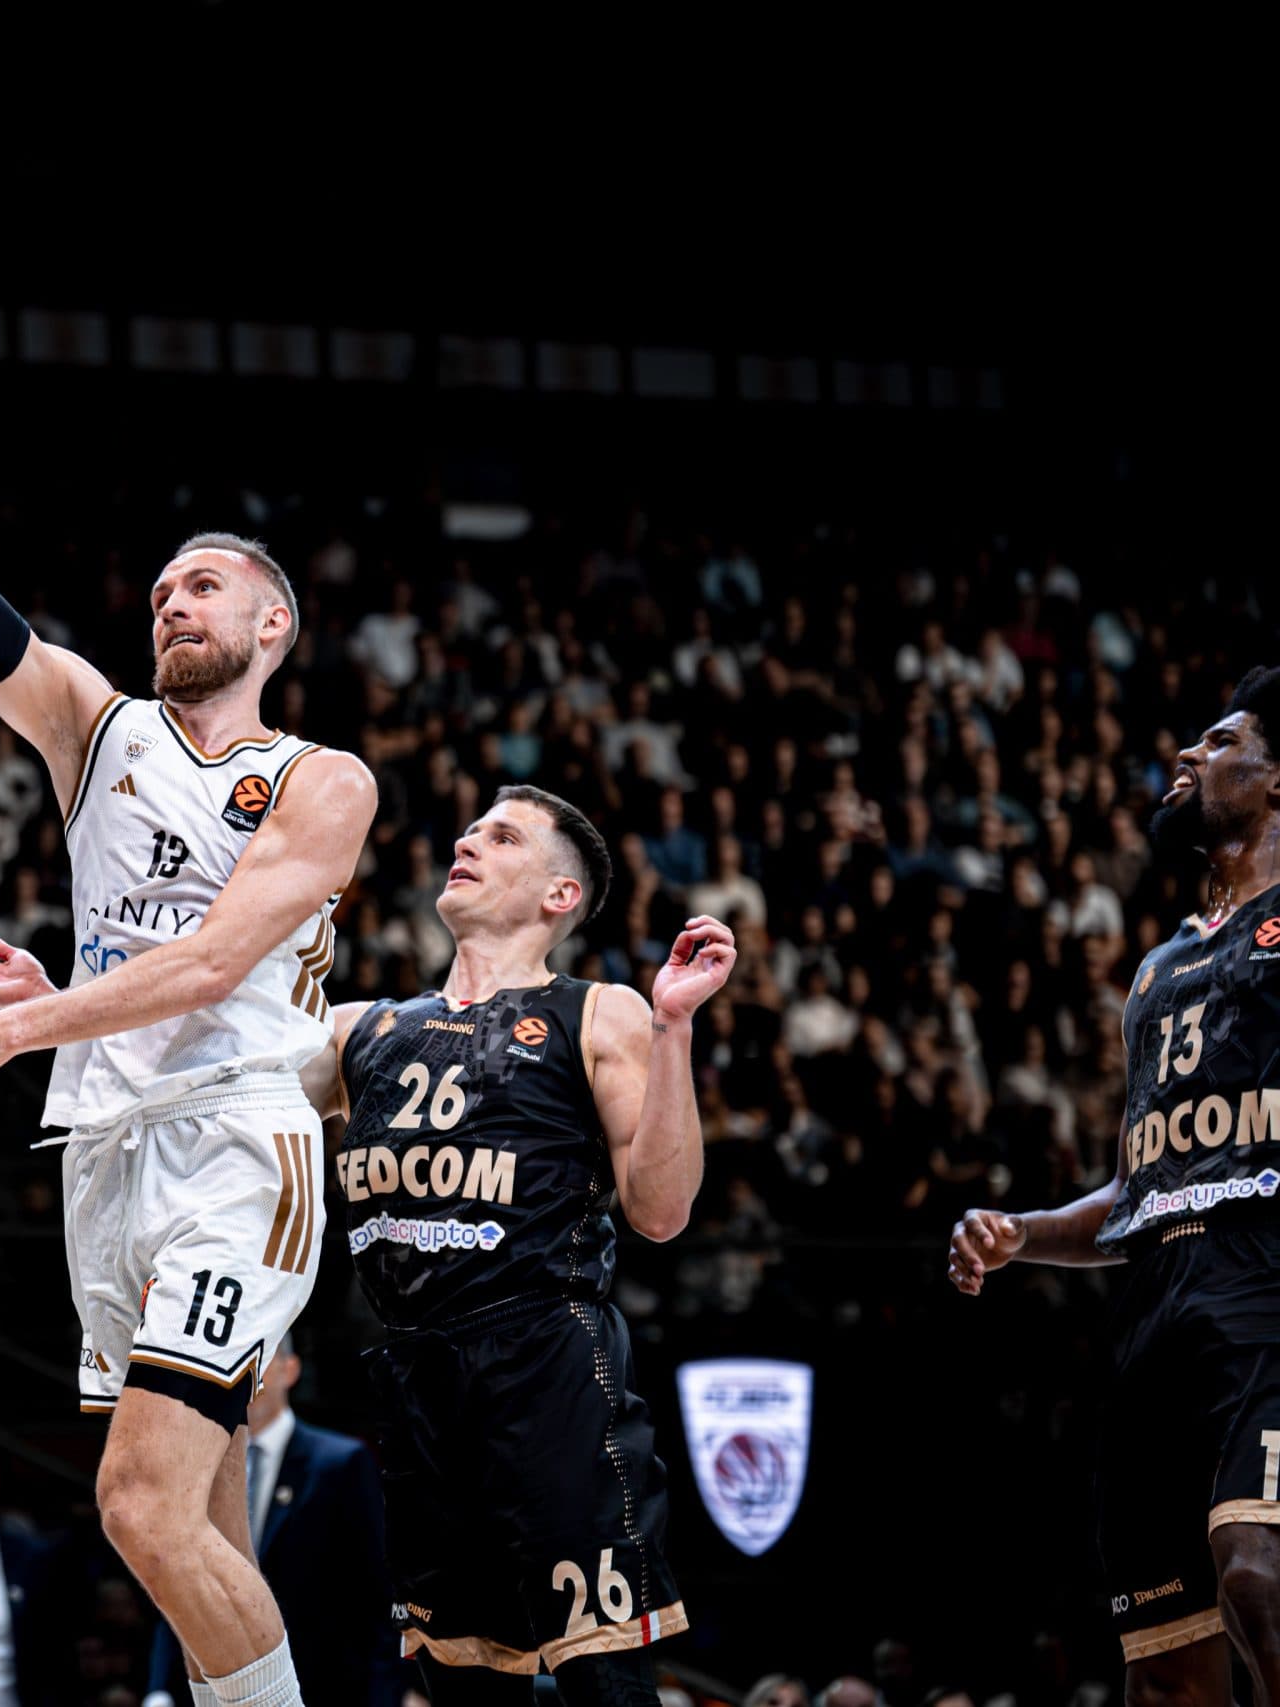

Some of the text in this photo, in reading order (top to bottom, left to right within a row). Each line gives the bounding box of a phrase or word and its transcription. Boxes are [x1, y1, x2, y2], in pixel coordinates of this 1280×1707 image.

[146, 829, 190, 879] 13
[422, 1019, 476, 1036] SPALDING
[1157, 1002, 1207, 1084] 13
[388, 1062, 466, 1130] 26
[183, 1269, 243, 1347] 13
[552, 1547, 633, 1638] 26
[1133, 1578, 1184, 1606] SPALDING
